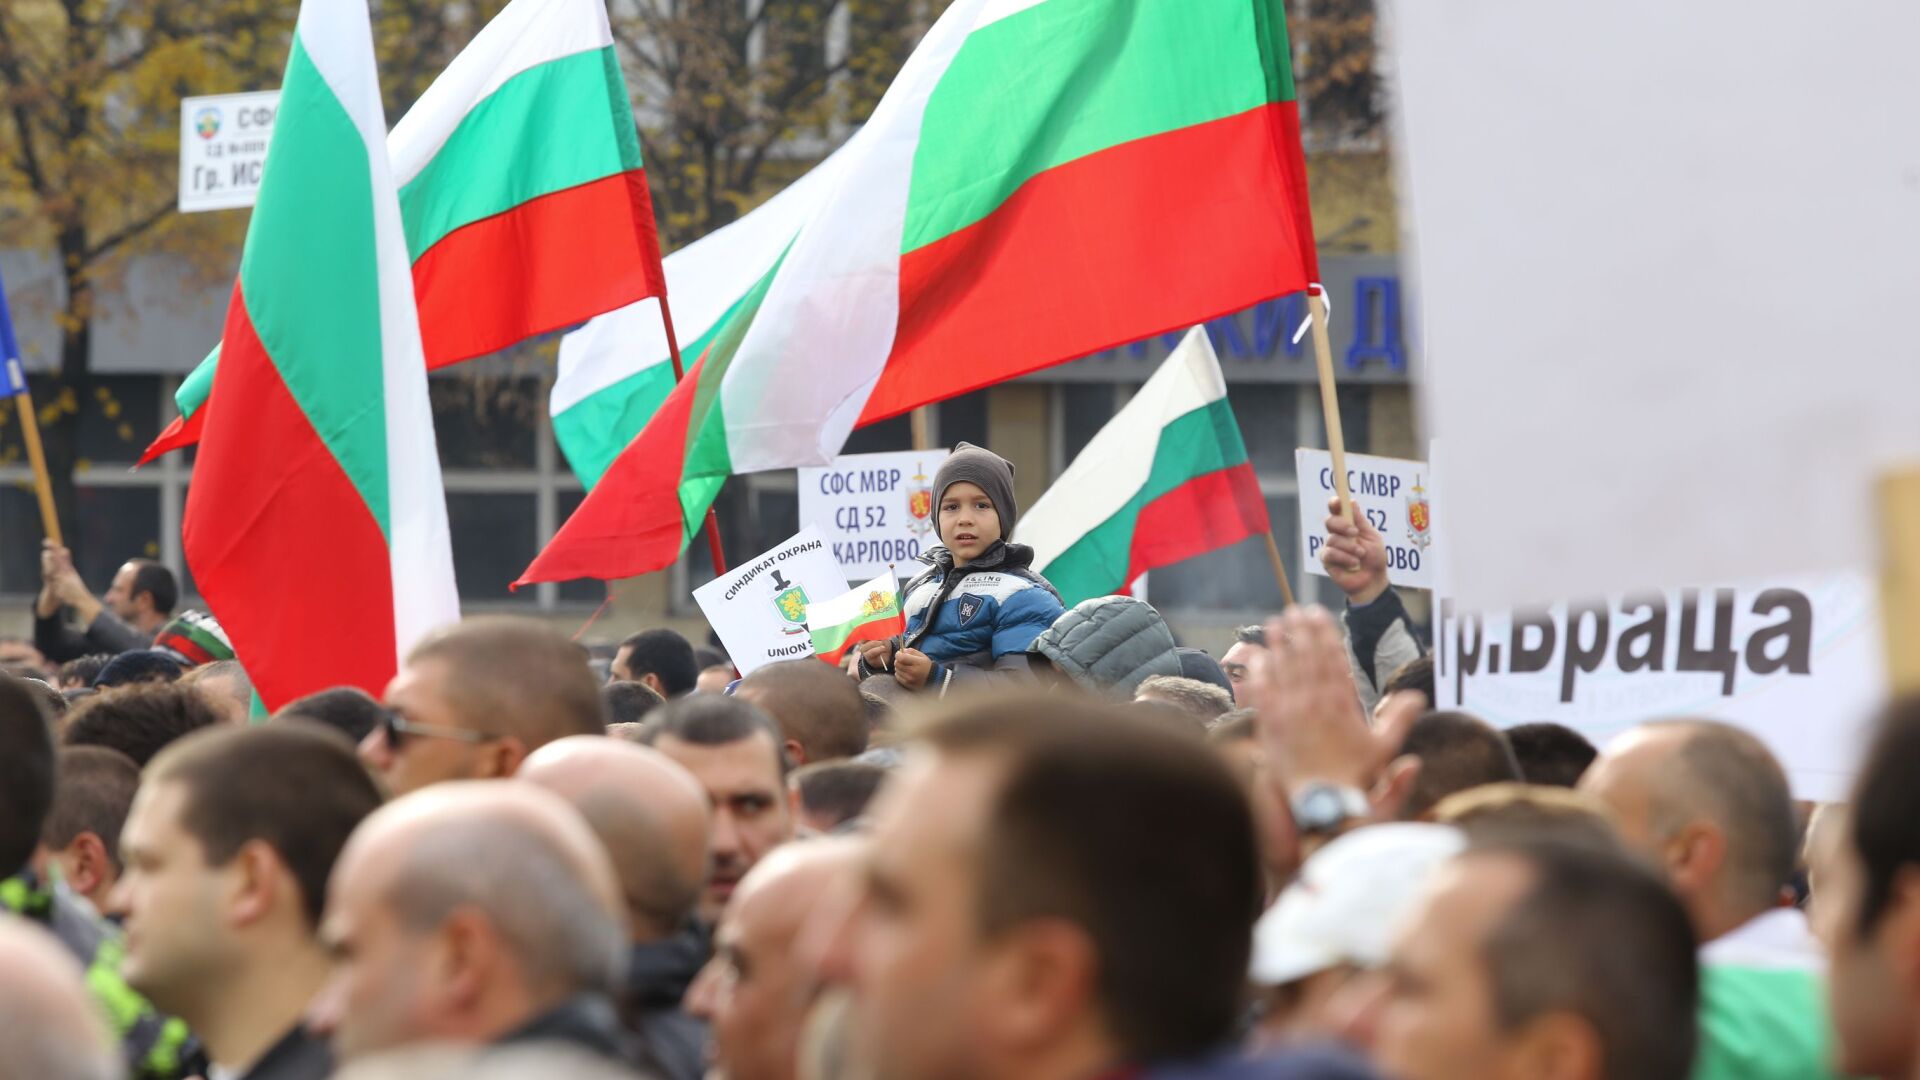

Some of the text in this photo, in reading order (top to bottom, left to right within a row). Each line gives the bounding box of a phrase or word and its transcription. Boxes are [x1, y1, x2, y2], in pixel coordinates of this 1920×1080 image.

[237, 106, 278, 129] СФ
[231, 160, 266, 187] ИС
[820, 469, 901, 495] СФС МВР
[1361, 471, 1400, 498] МВР
[836, 505, 886, 533] СД 52
[1366, 508, 1387, 532] 52
[833, 538, 919, 564] КАРЛОВО
[725, 539, 822, 601] СИНДИКАТ ОХРАНА
[767, 642, 807, 657] UNION
